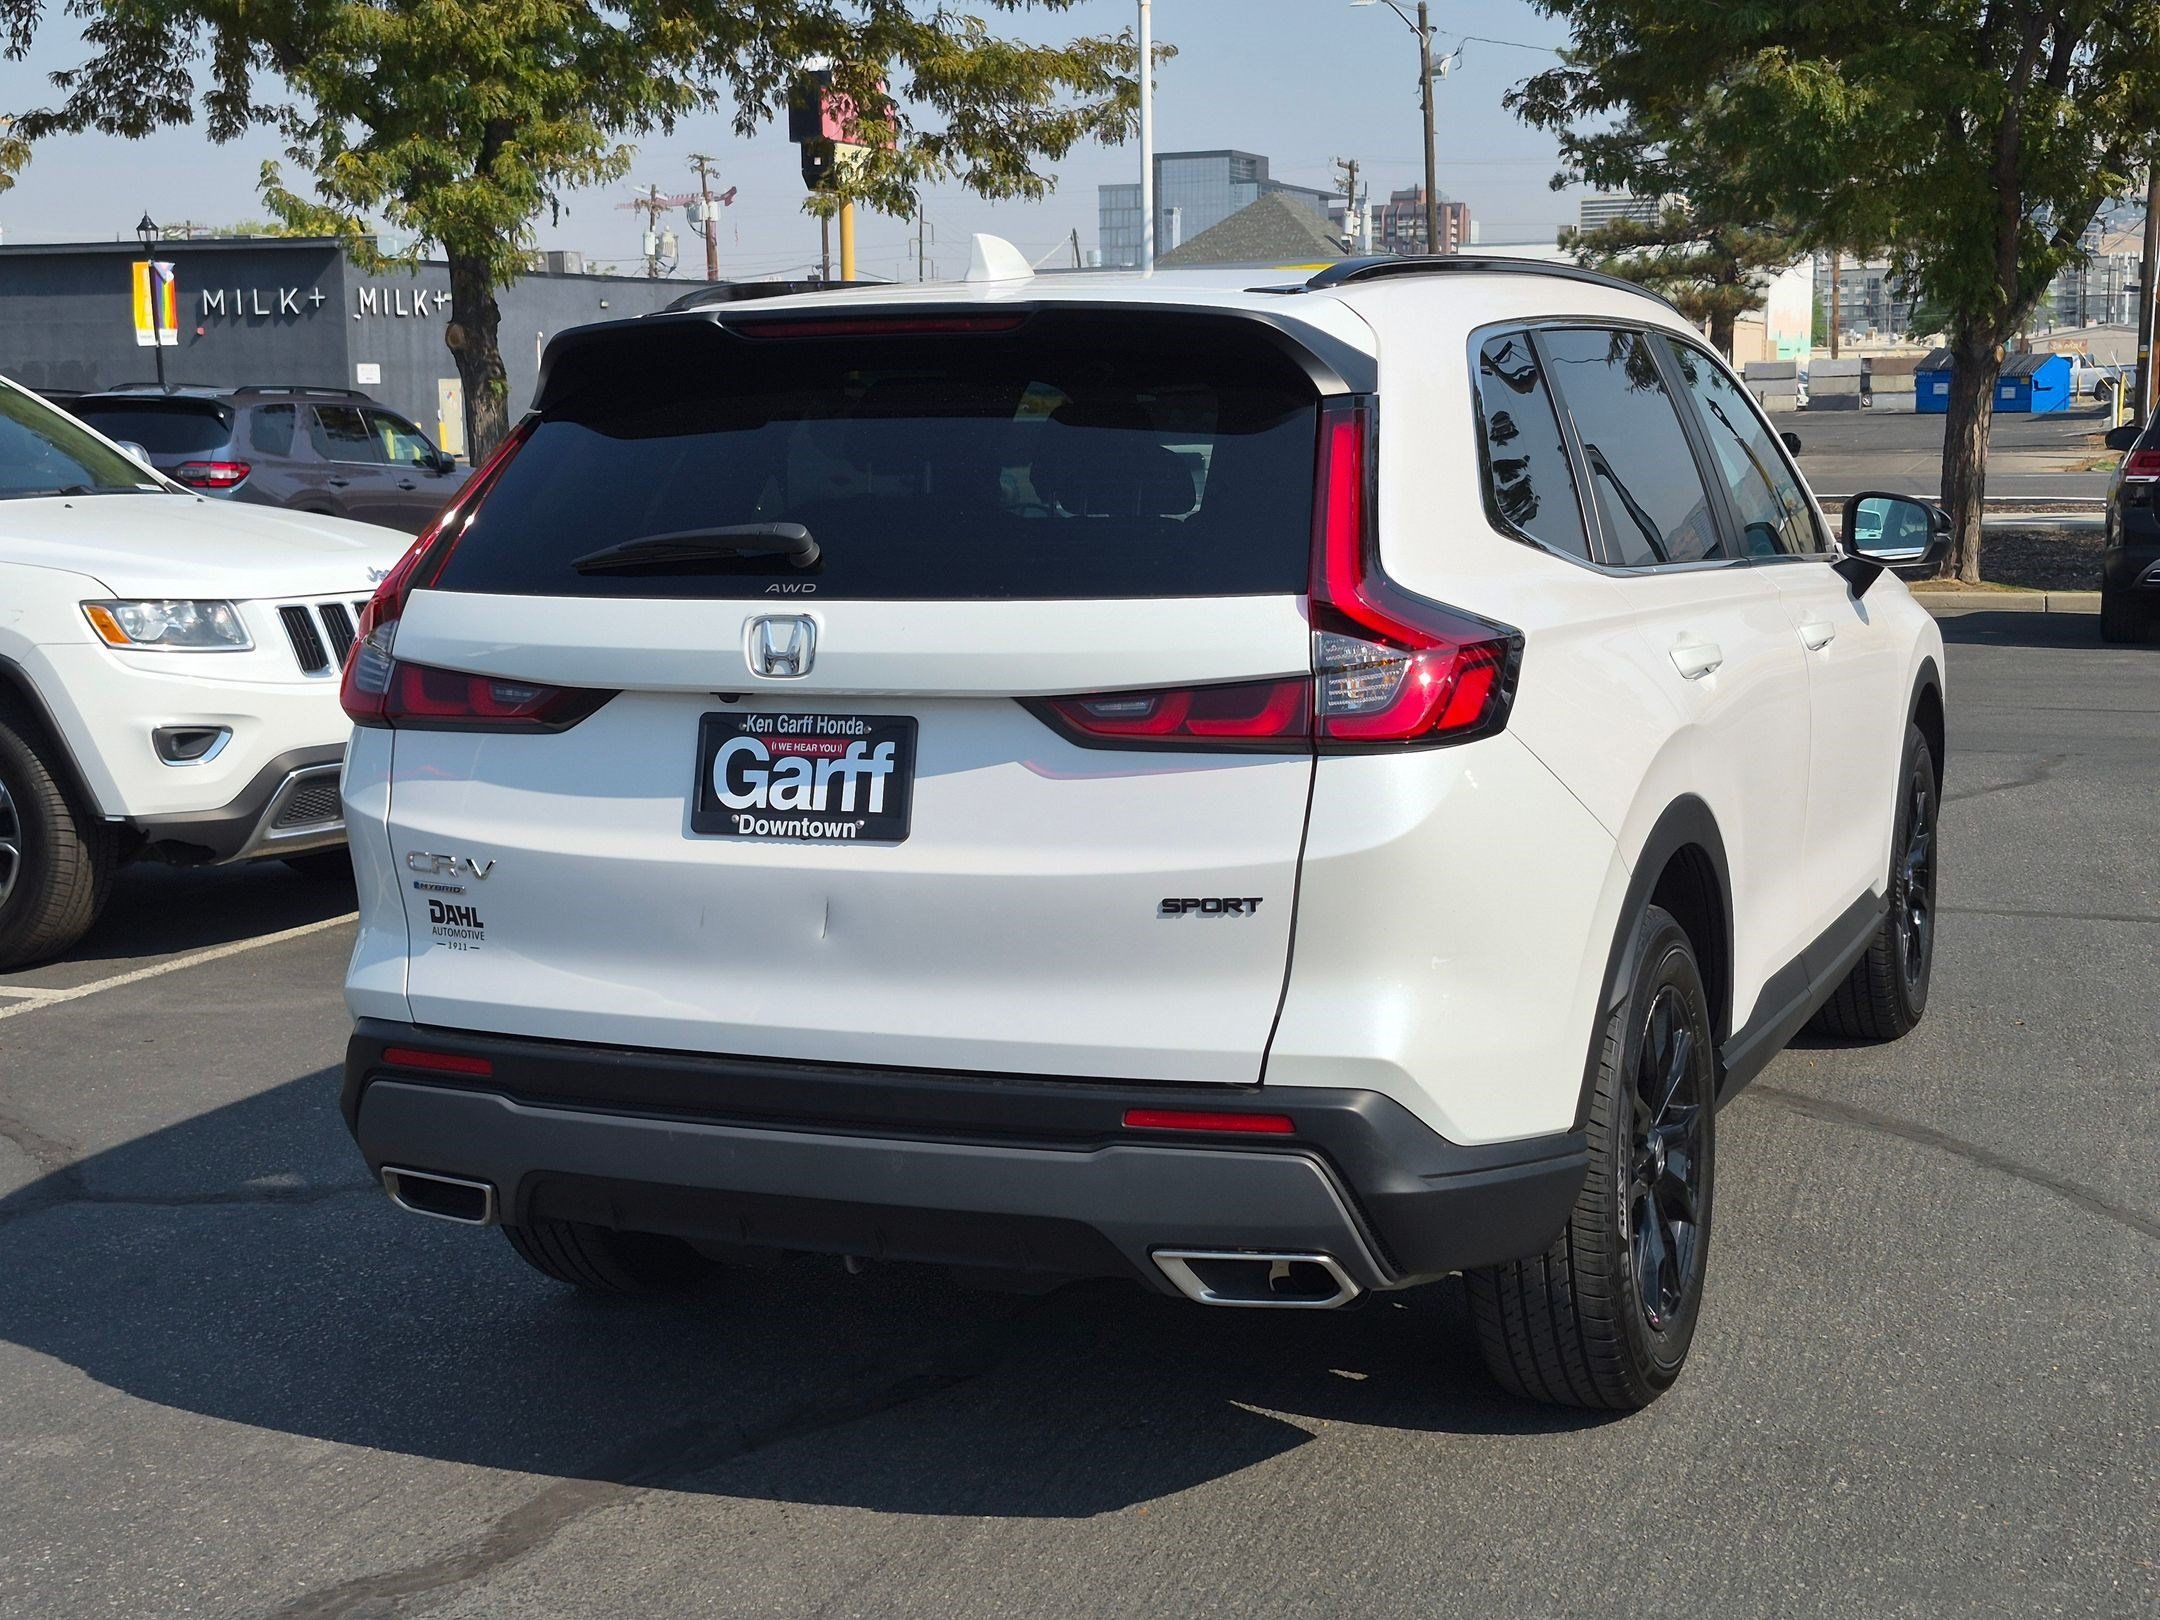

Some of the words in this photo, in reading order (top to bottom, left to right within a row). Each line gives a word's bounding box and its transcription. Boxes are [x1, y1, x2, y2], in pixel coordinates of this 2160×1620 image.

[203, 287, 326, 315] MILK+
[765, 583, 817, 593] AWD
[746, 714, 773, 733] Ken
[777, 714, 814, 733] Garff
[816, 715, 864, 735] Honda
[778, 742, 792, 751] WE
[793, 743, 818, 752] HEAR
[819, 743, 837, 753] YOU
[712, 736, 896, 814] Garff
[738, 814, 857, 838] Downtown
[406, 850, 497, 881] CR-V
[428, 899, 485, 929] DAHL
[1161, 896, 1264, 914] SPORT
[432, 926, 486, 941] AUTOMOTIVE
[448, 941, 468, 951] 1911
